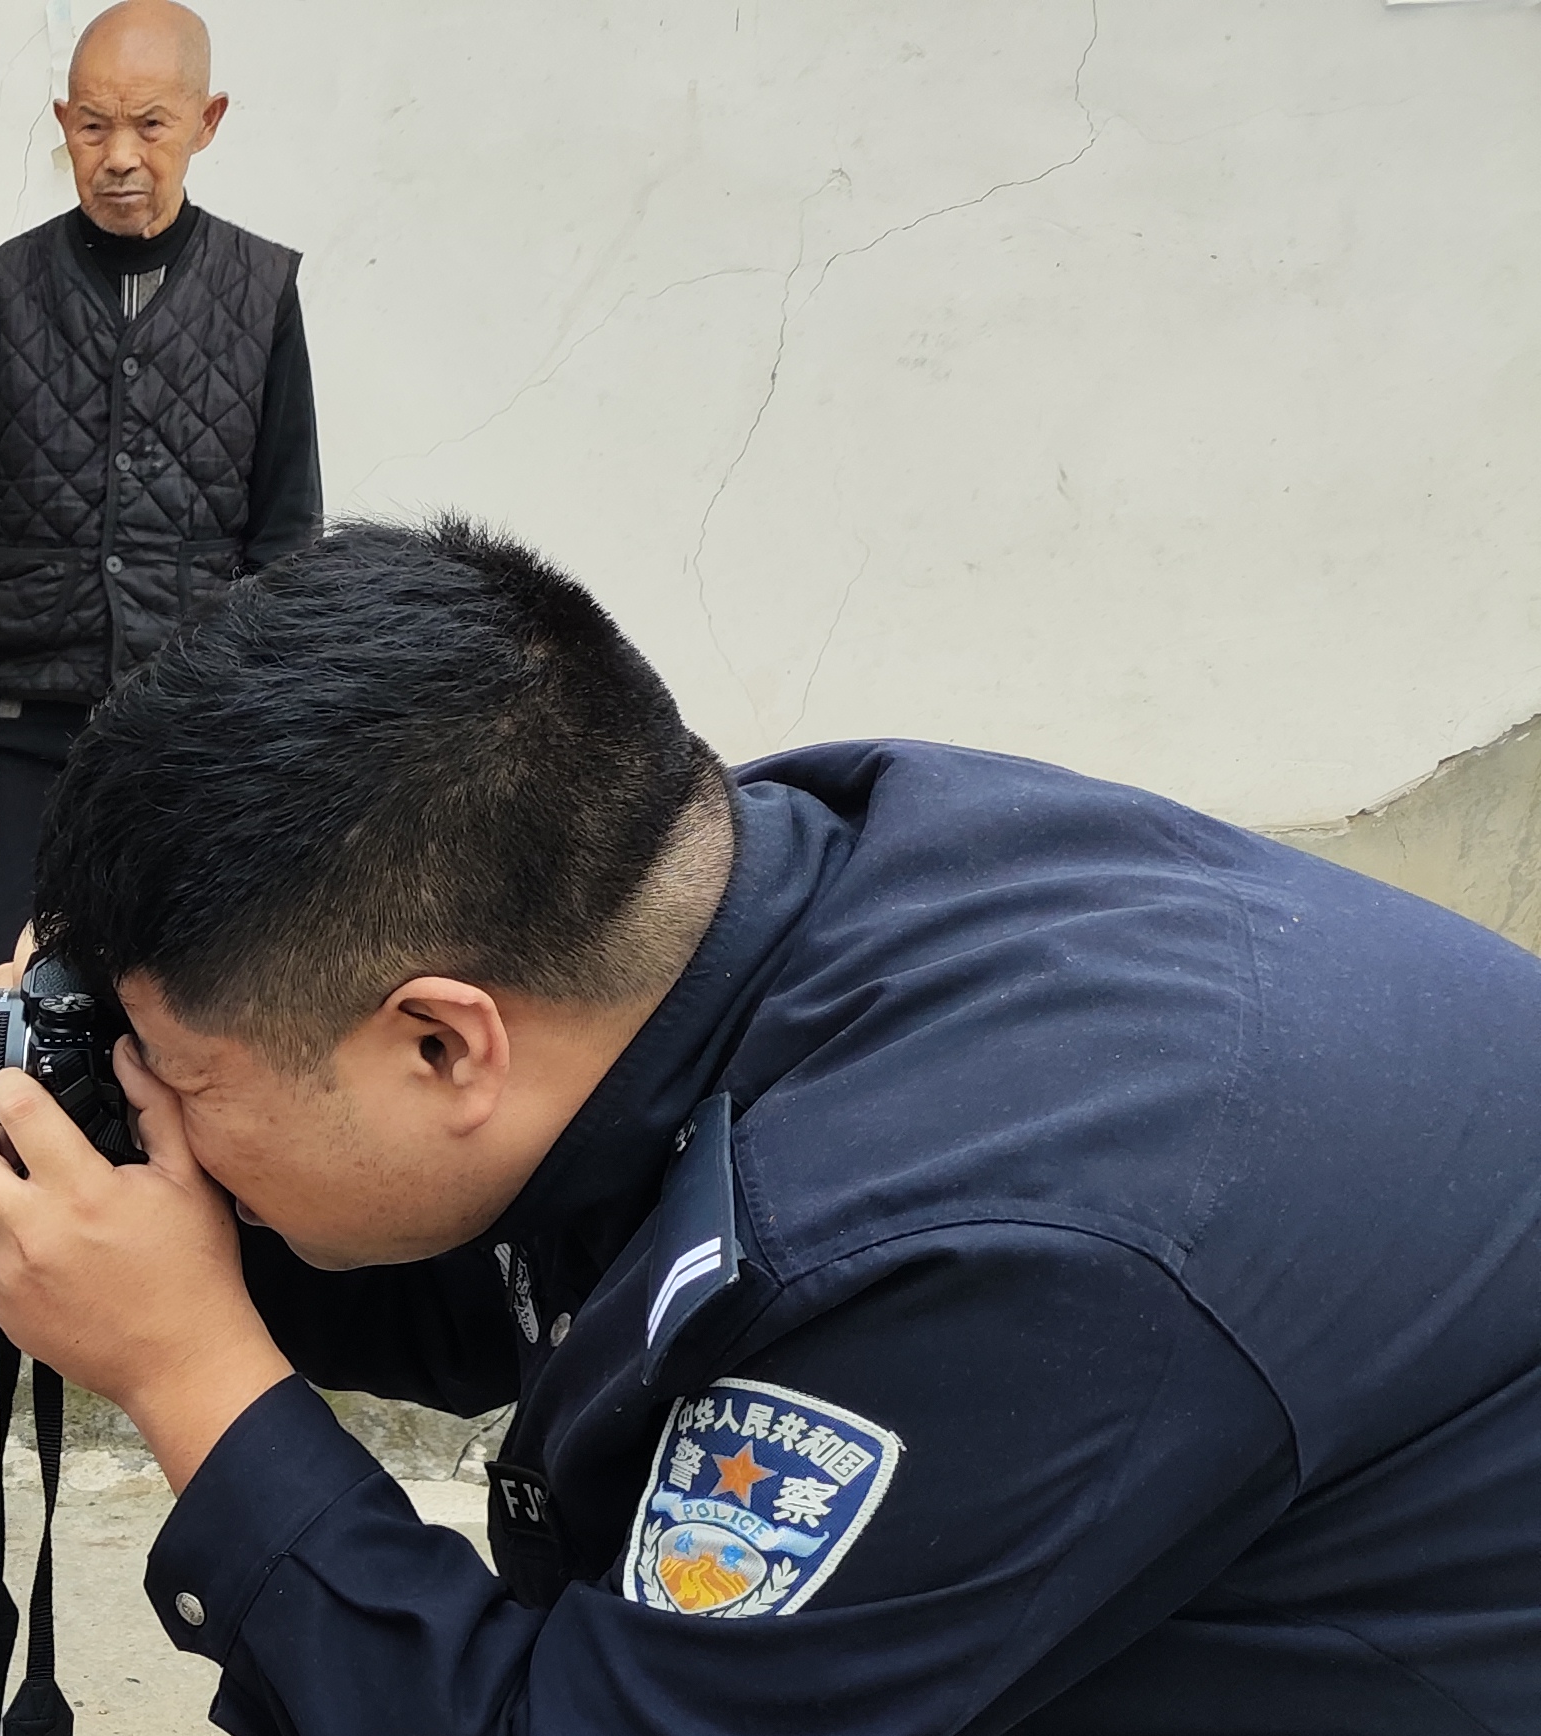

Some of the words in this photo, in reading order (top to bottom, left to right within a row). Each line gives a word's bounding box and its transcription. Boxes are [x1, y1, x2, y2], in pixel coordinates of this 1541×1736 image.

[678, 1397, 875, 1486] 中华人民共和国
[683, 1502, 769, 1540] POLICE
